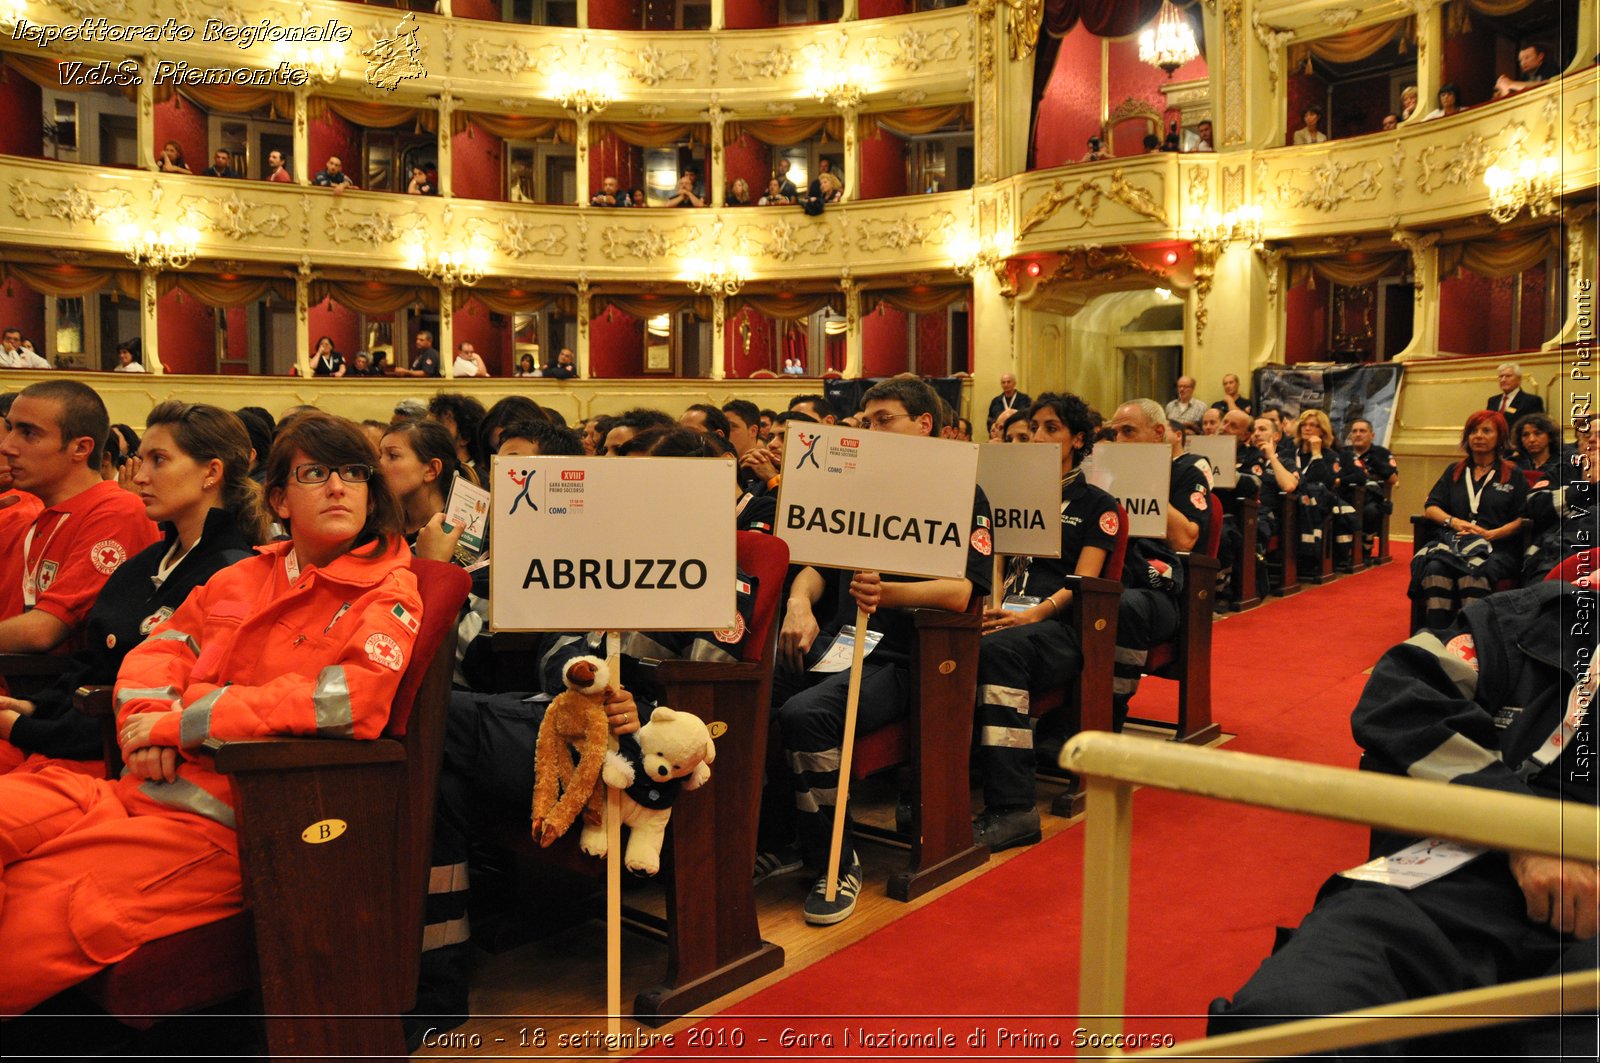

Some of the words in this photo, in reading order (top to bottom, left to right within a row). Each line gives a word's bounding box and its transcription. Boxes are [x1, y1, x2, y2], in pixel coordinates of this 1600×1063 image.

[828, 466, 843, 474] COMO
[548, 507, 567, 515] COMO
[786, 503, 962, 548] BASILICATA
[522, 558, 708, 590] ABRUZZO
[711, 724, 719, 737] C
[319, 823, 332, 840] B
